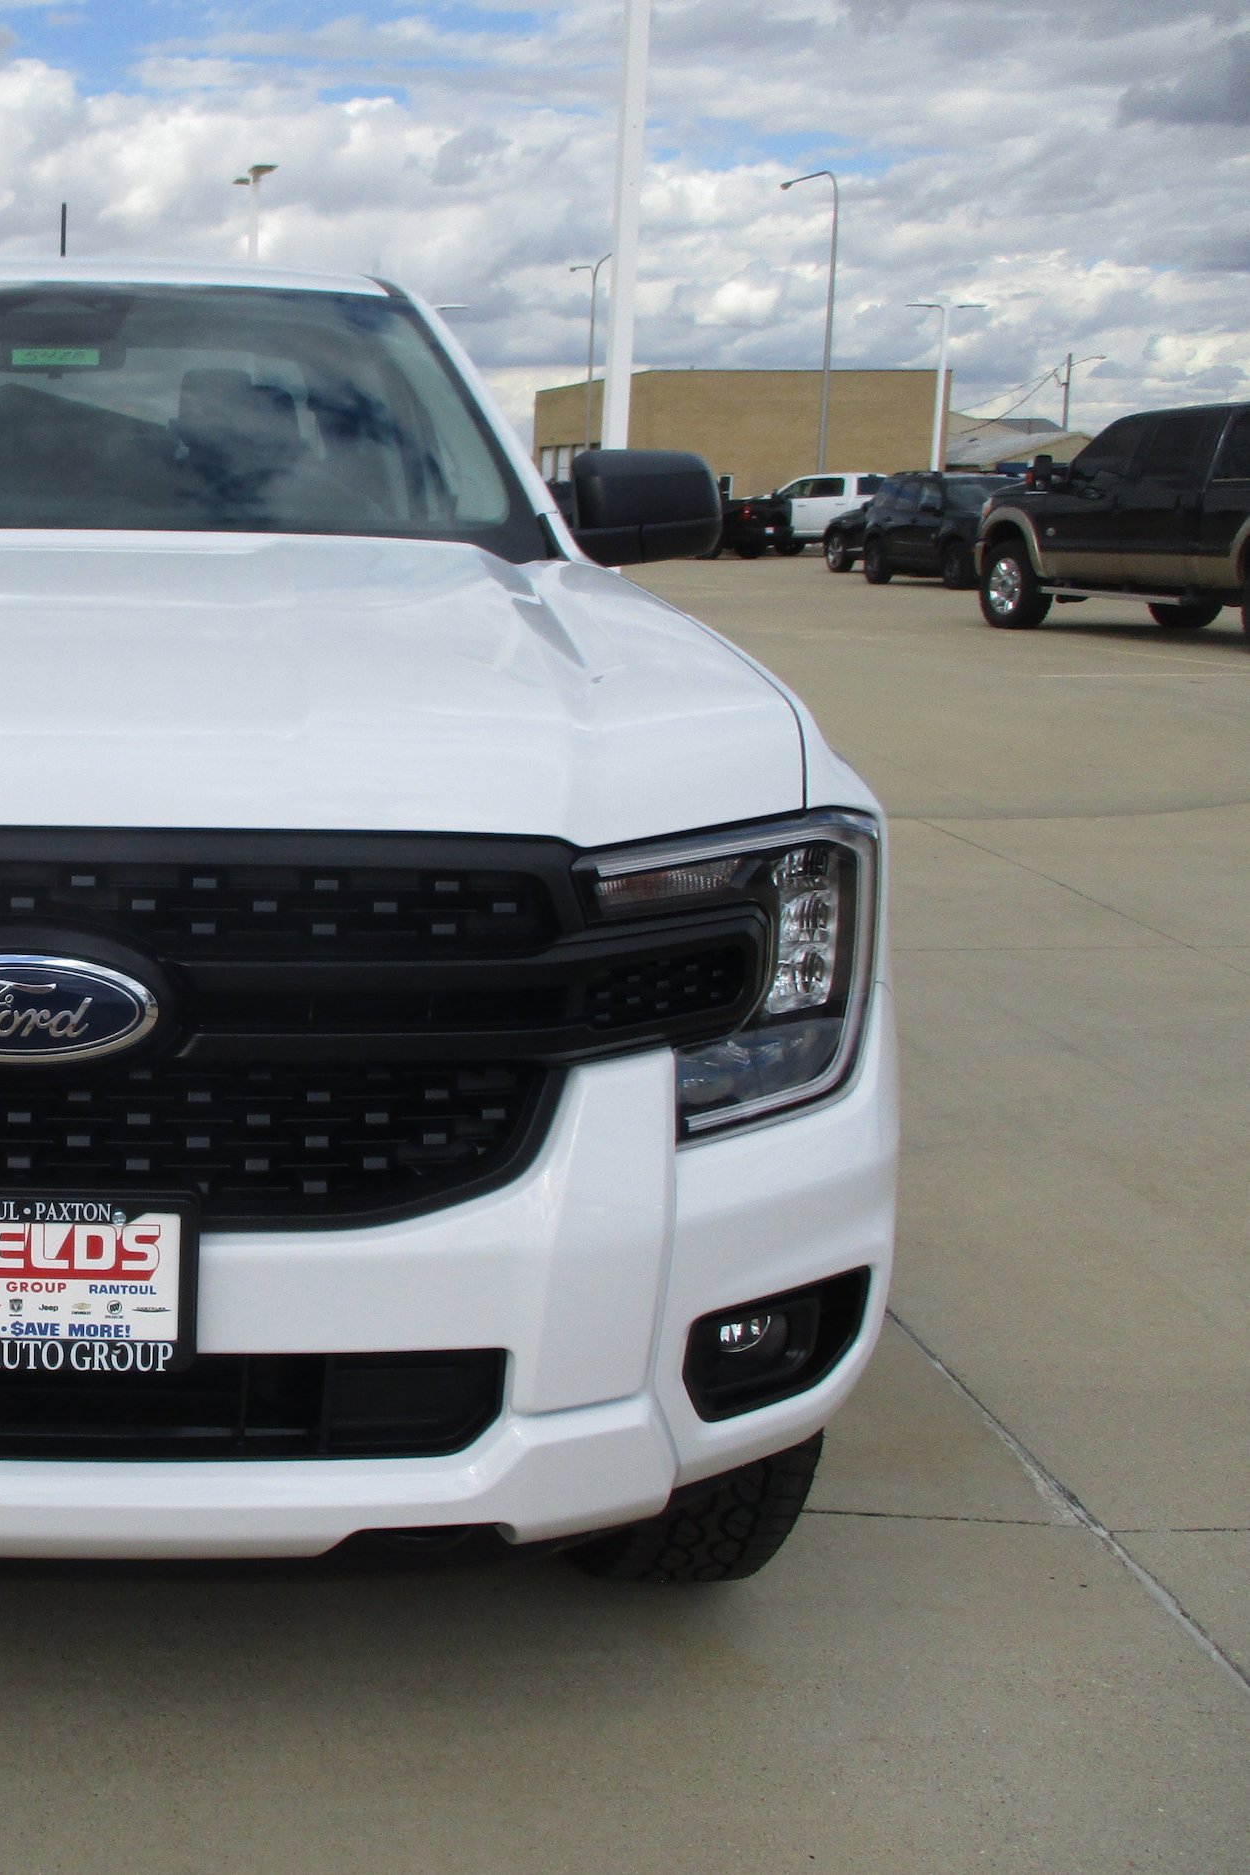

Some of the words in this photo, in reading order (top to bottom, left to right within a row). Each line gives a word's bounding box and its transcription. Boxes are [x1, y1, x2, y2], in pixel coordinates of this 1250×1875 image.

[35, 1203, 111, 1222] PAXTON
[6, 1281, 67, 1294] GROUP
[89, 1284, 157, 1295] RANTOUL
[38, 1304, 59, 1312] Jeep
[10, 1320, 60, 1337] $AVE
[68, 1323, 131, 1338] MORE!
[70, 1341, 174, 1372] GROUP
